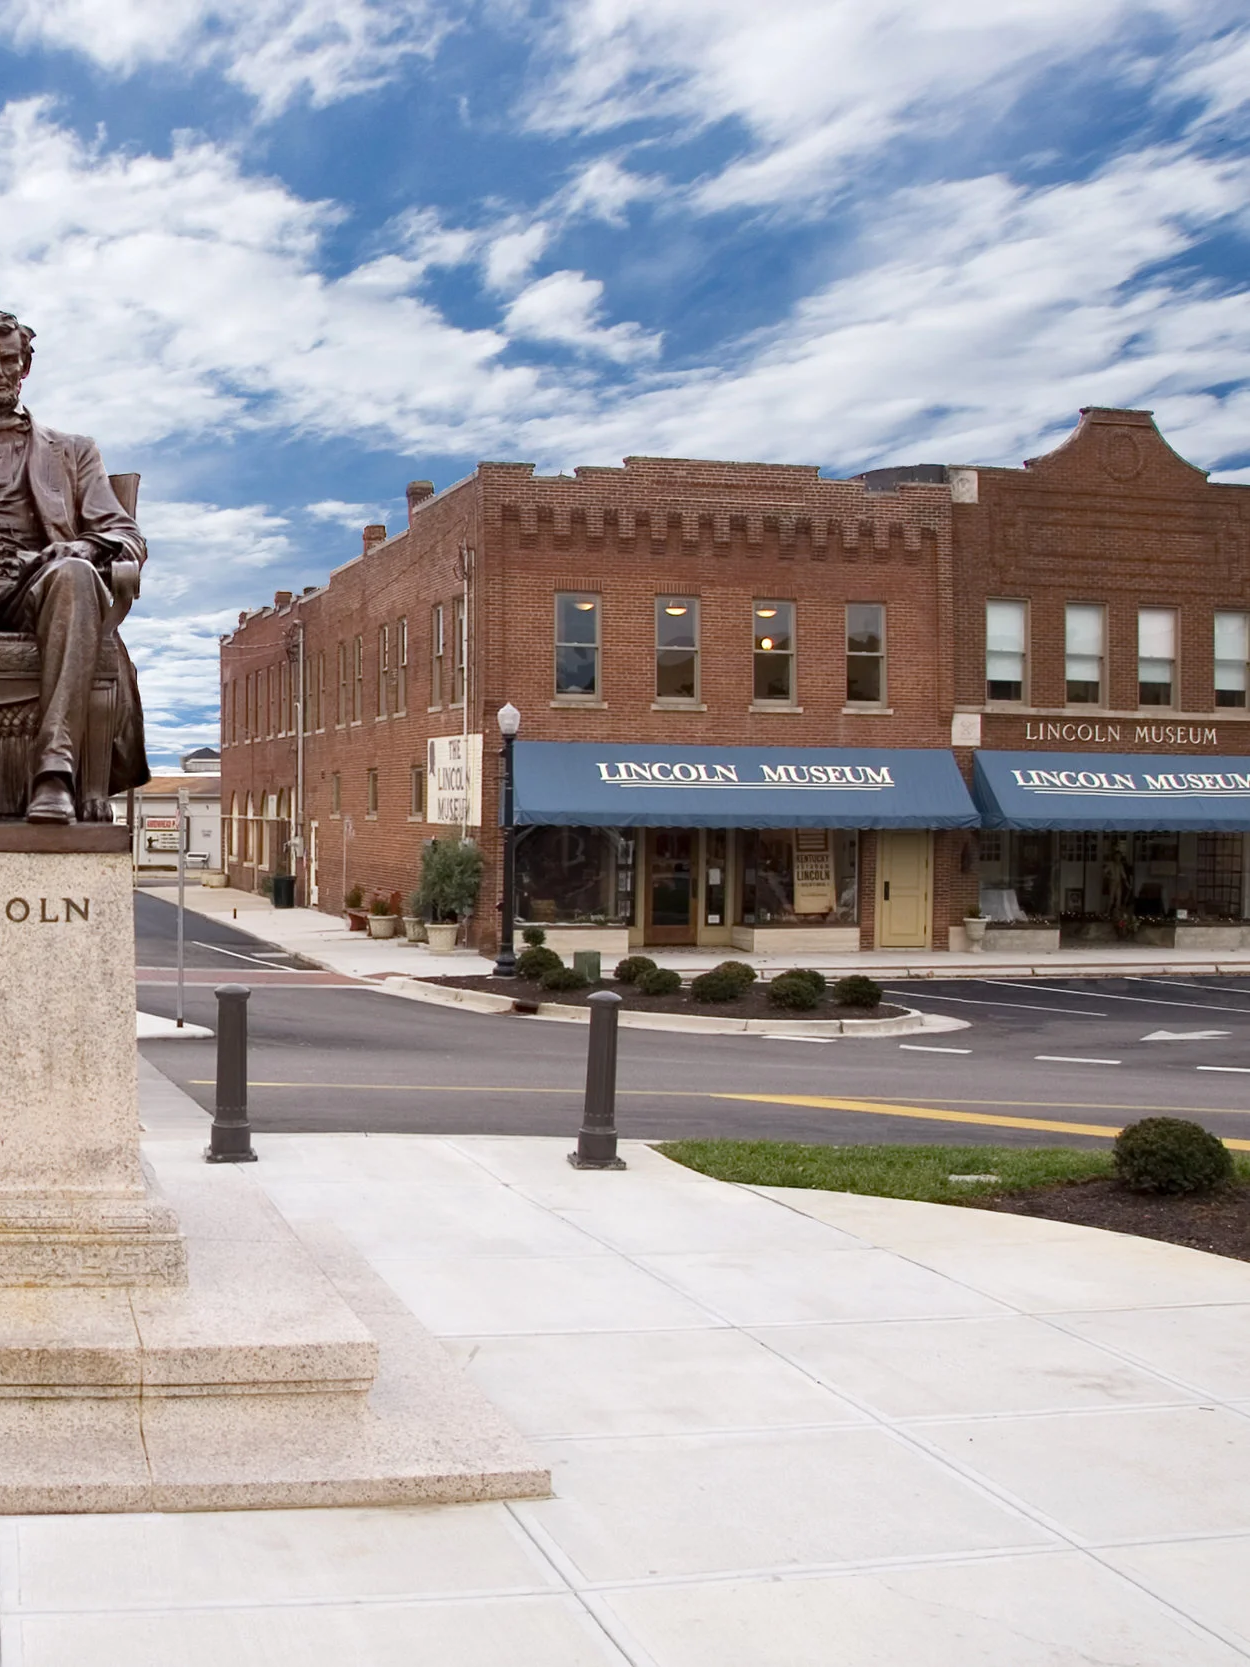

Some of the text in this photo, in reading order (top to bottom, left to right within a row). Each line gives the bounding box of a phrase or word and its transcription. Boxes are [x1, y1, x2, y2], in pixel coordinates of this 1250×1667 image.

[1025, 722, 1218, 745] LINCOLN MUSEUM
[448, 739, 462, 760] THE
[595, 762, 895, 784] LINCOLN MUSEUM
[1010, 769, 1137, 790] LINCOLN
[796, 870, 831, 881] LINCOLN
